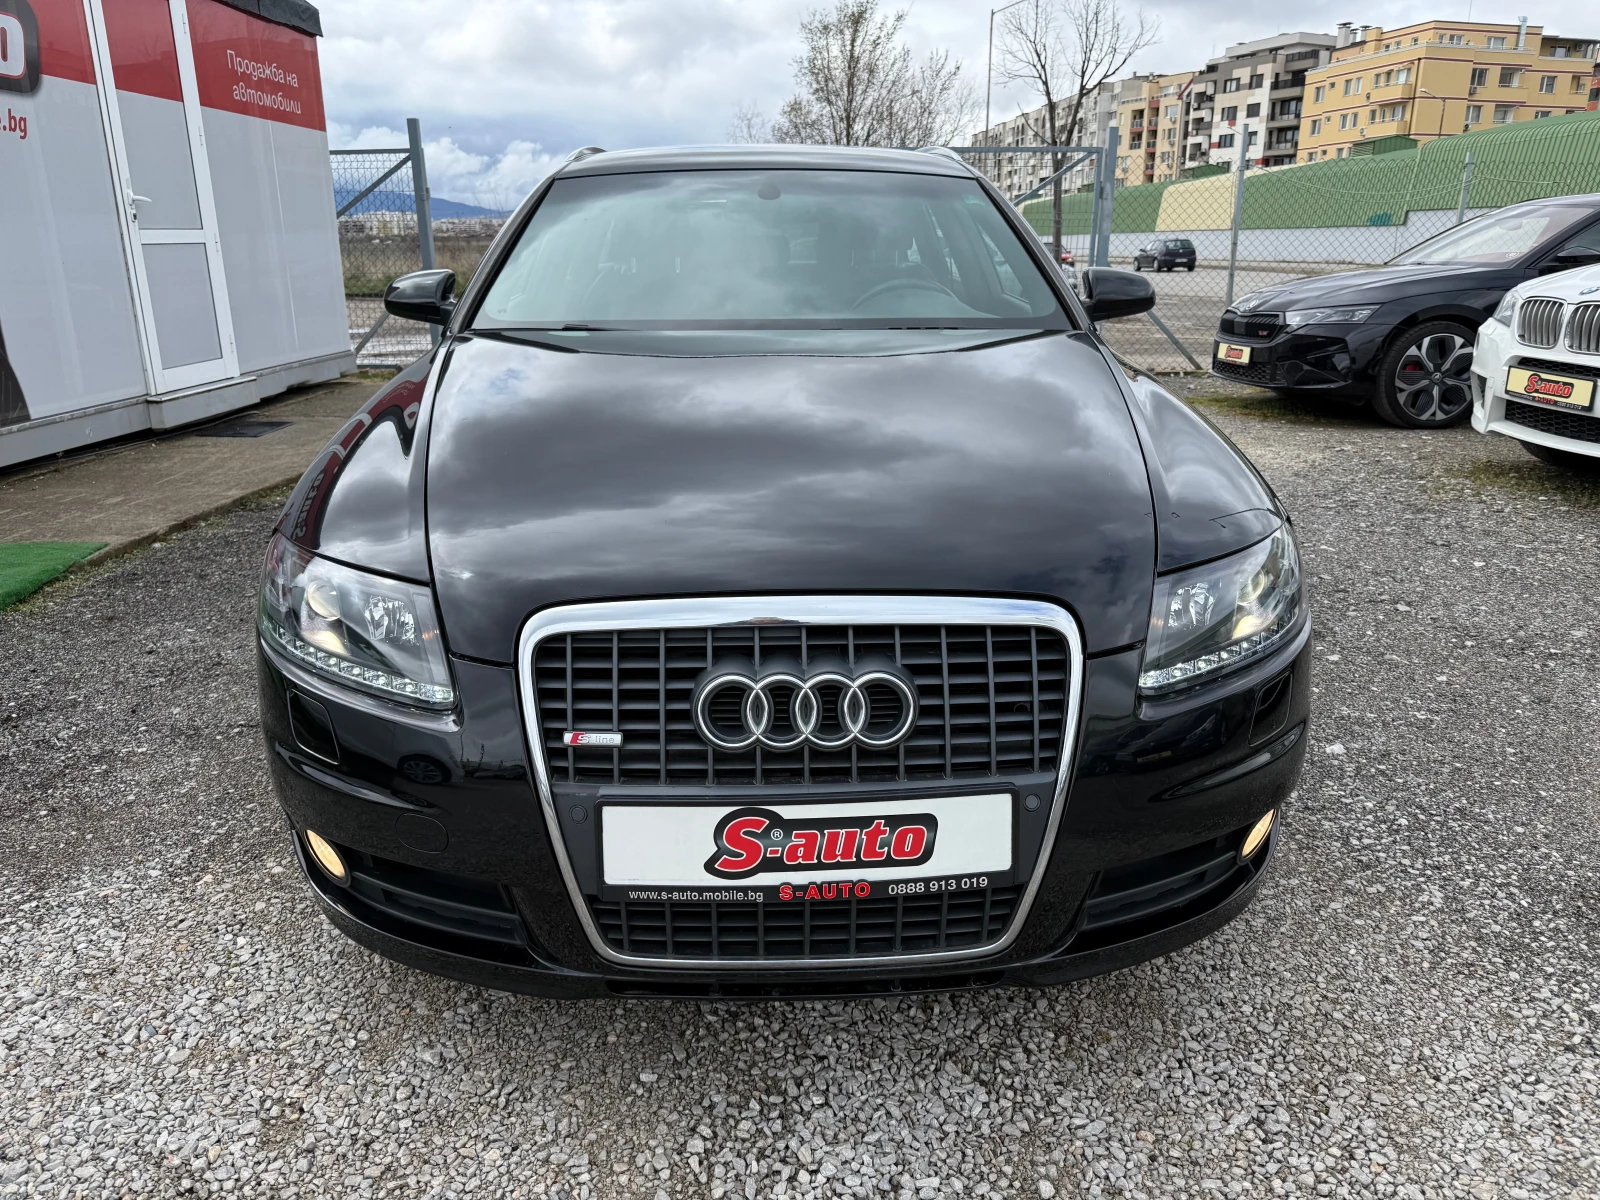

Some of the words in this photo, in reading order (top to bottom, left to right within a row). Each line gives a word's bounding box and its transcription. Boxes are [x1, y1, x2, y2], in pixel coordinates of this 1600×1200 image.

[227, 49, 285, 83] Продажба
[286, 71, 299, 88] на
[232, 81, 301, 115] автомобили
[0, 107, 28, 140] .bg
[1525, 375, 1573, 397] S-auto
[595, 735, 615, 744] line
[714, 816, 928, 872] S-auto
[628, 889, 764, 903] www.s-auto.mobile.bg
[778, 882, 871, 901] S-AUTO
[888, 882, 925, 895] 0888
[929, 879, 957, 892] 913
[960, 876, 989, 889] 019
